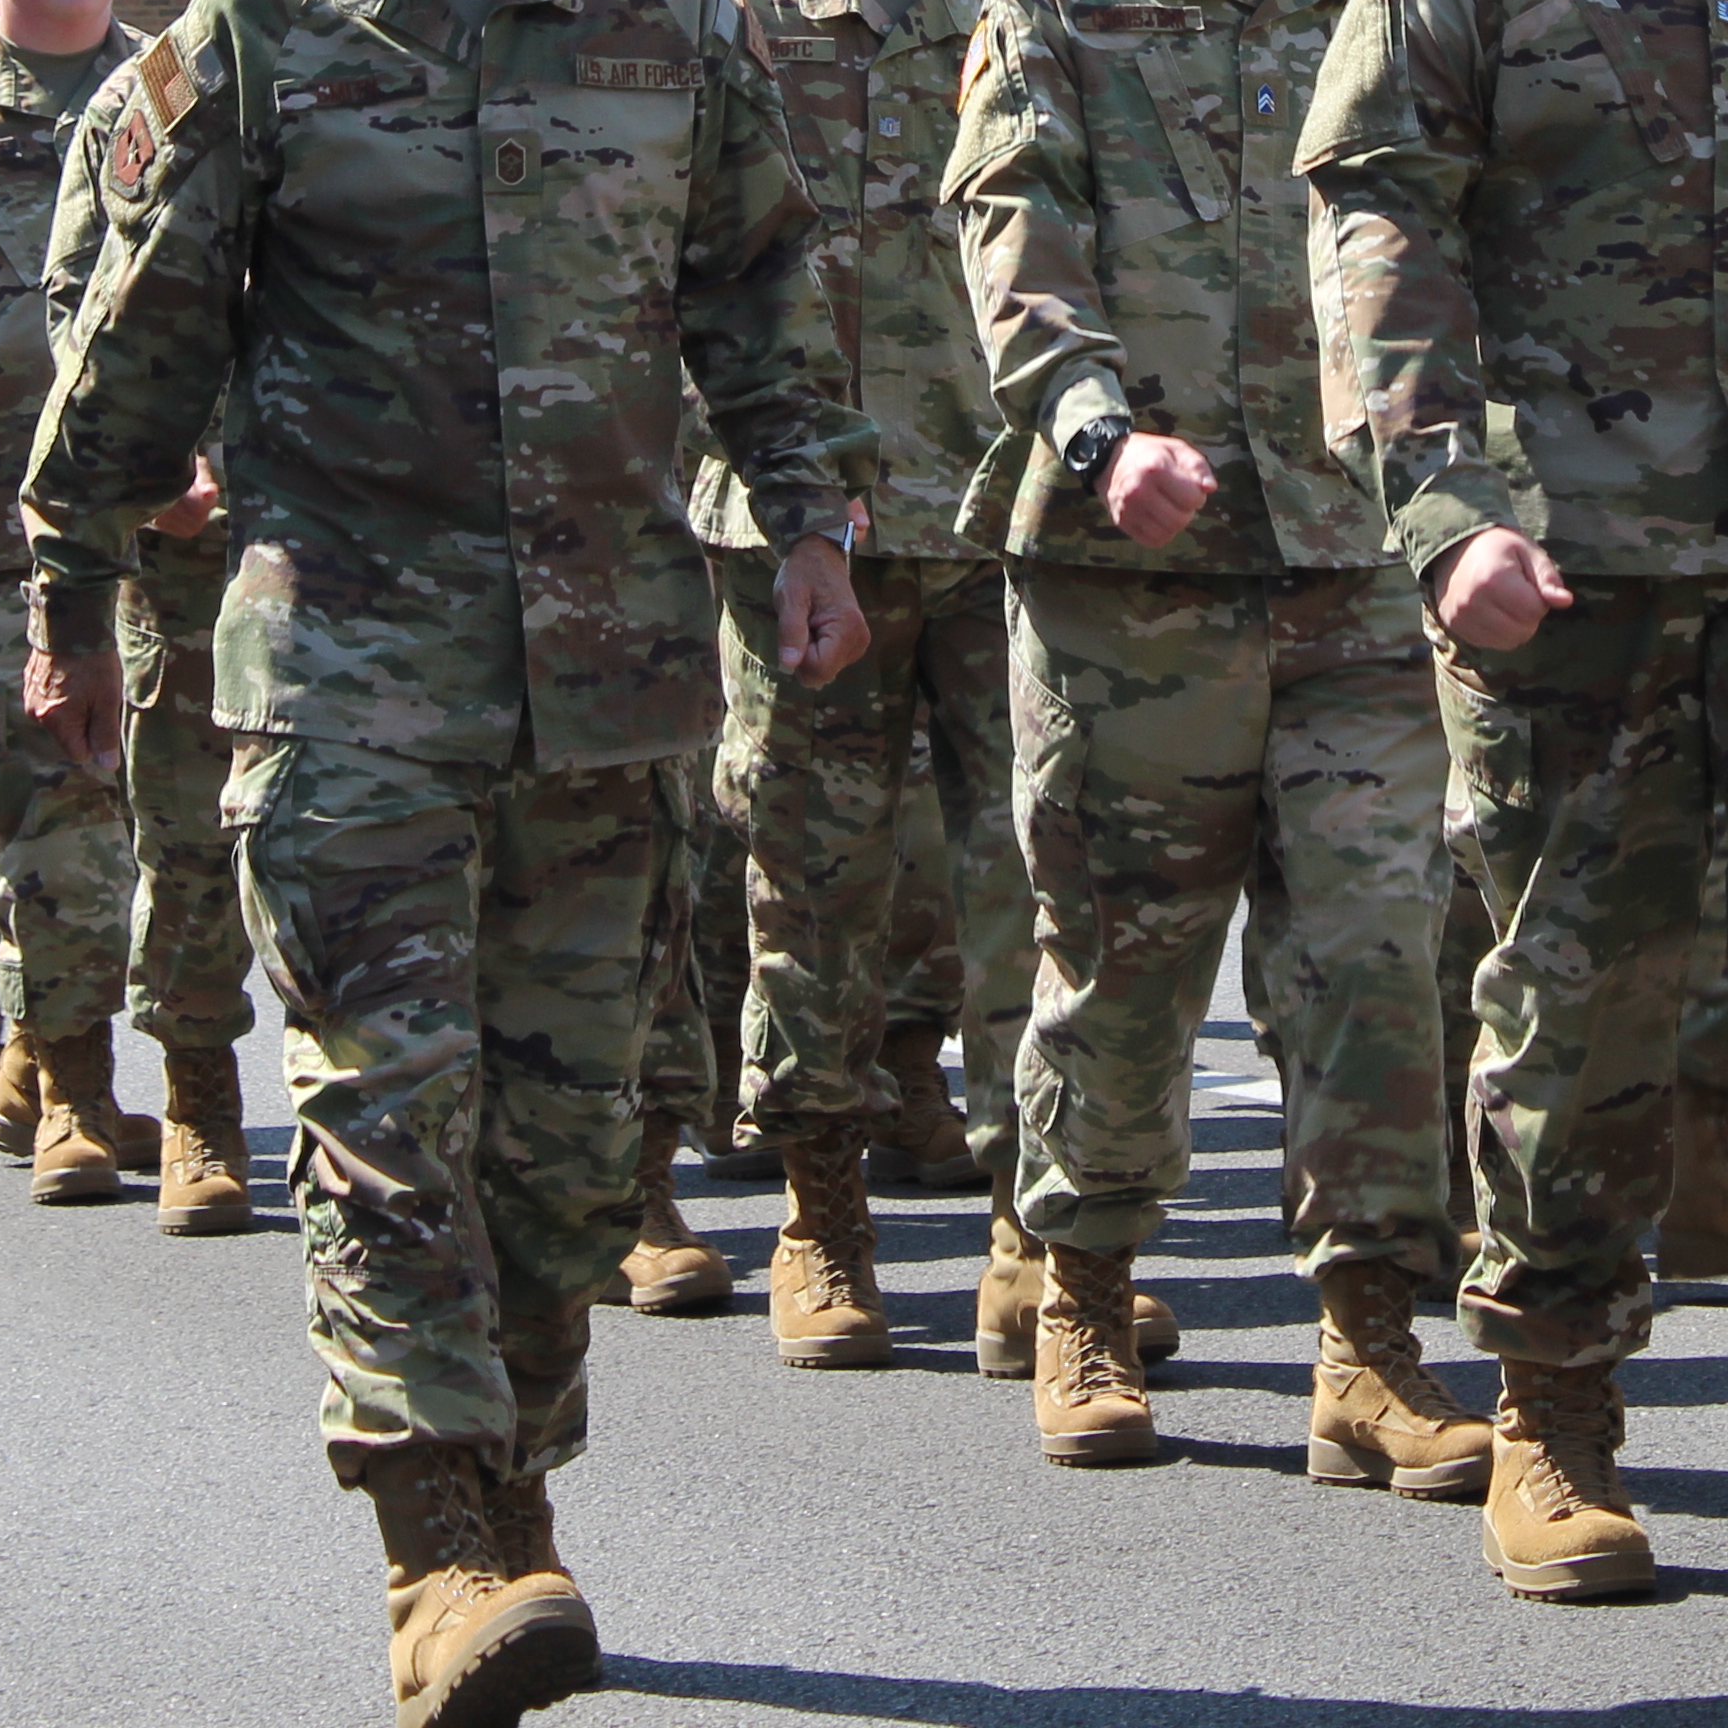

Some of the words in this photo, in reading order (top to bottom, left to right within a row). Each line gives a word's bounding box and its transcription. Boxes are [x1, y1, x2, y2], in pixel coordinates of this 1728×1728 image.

[579, 59, 604, 83] U.S.
[610, 62, 638, 84] AIR
[645, 63, 702, 87] FORCE
